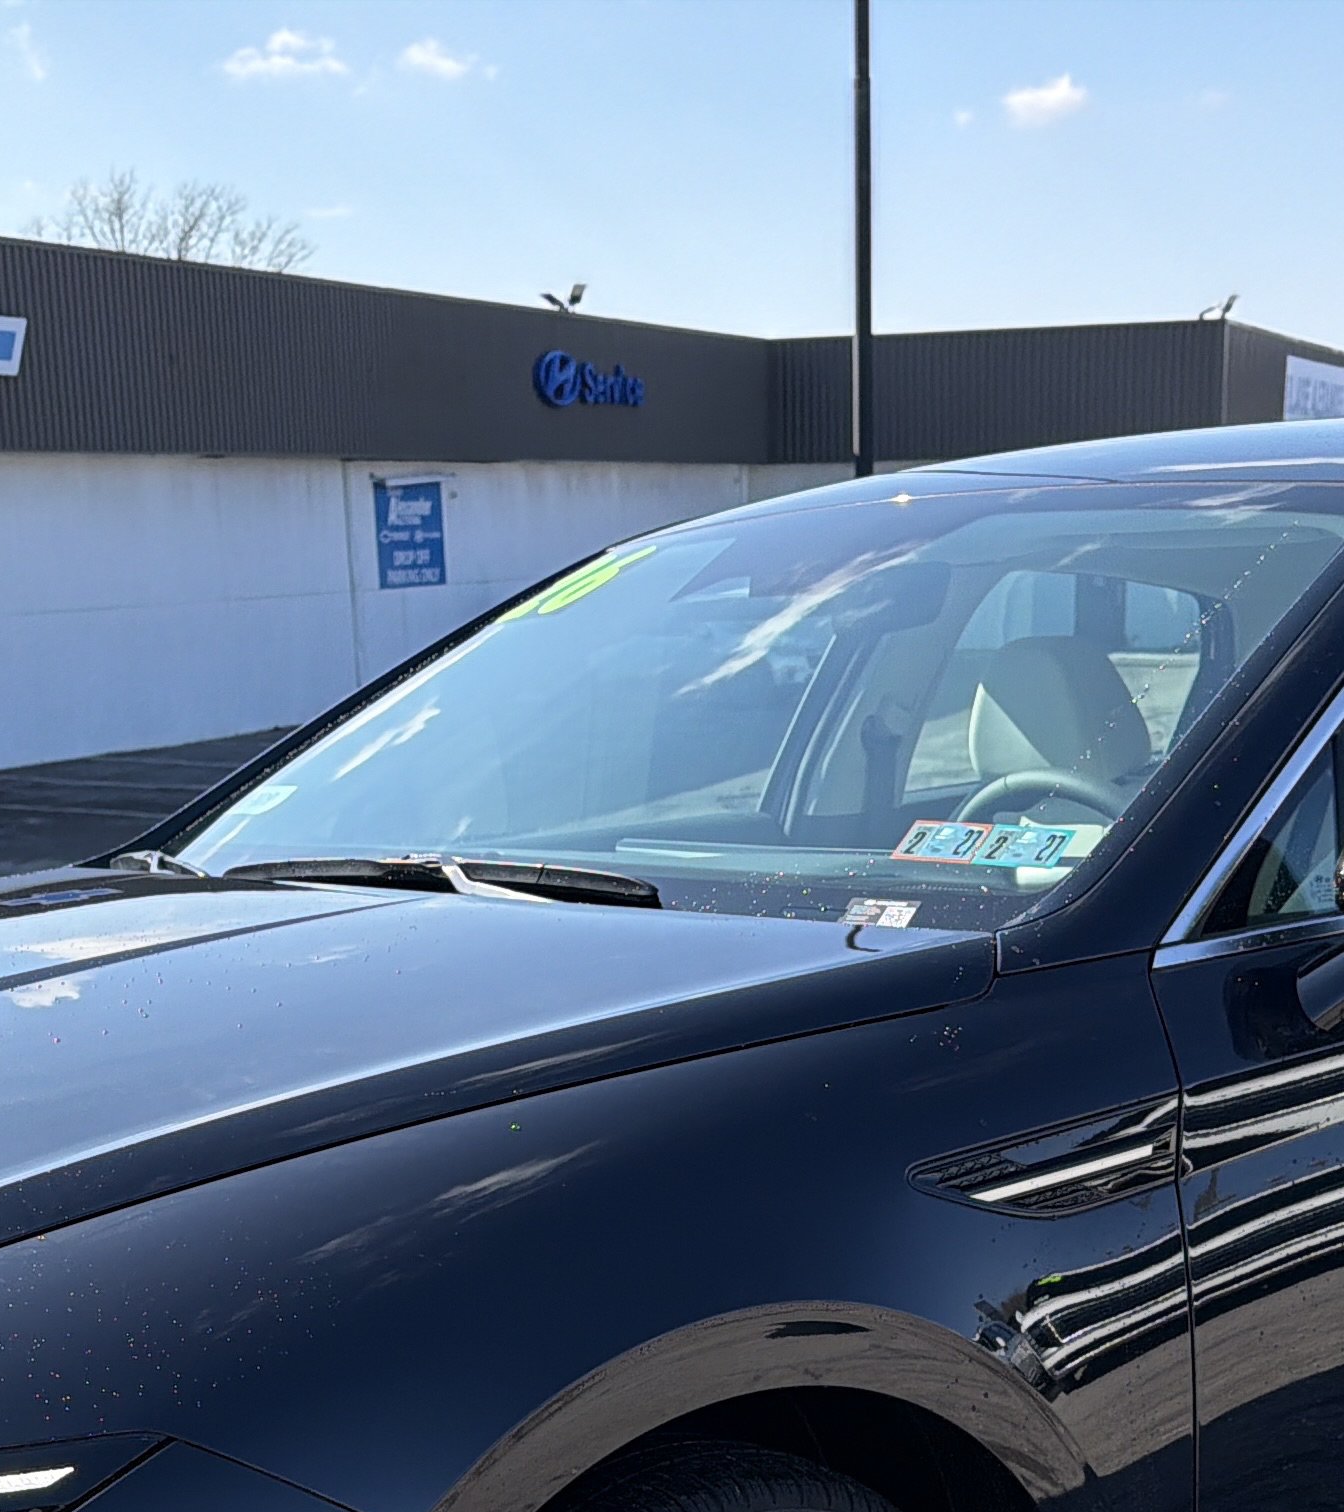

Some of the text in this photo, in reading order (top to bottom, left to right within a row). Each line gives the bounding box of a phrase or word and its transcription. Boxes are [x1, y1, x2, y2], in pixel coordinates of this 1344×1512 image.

[903, 829, 985, 857] 2 27
[985, 834, 1067, 863] 2 27
